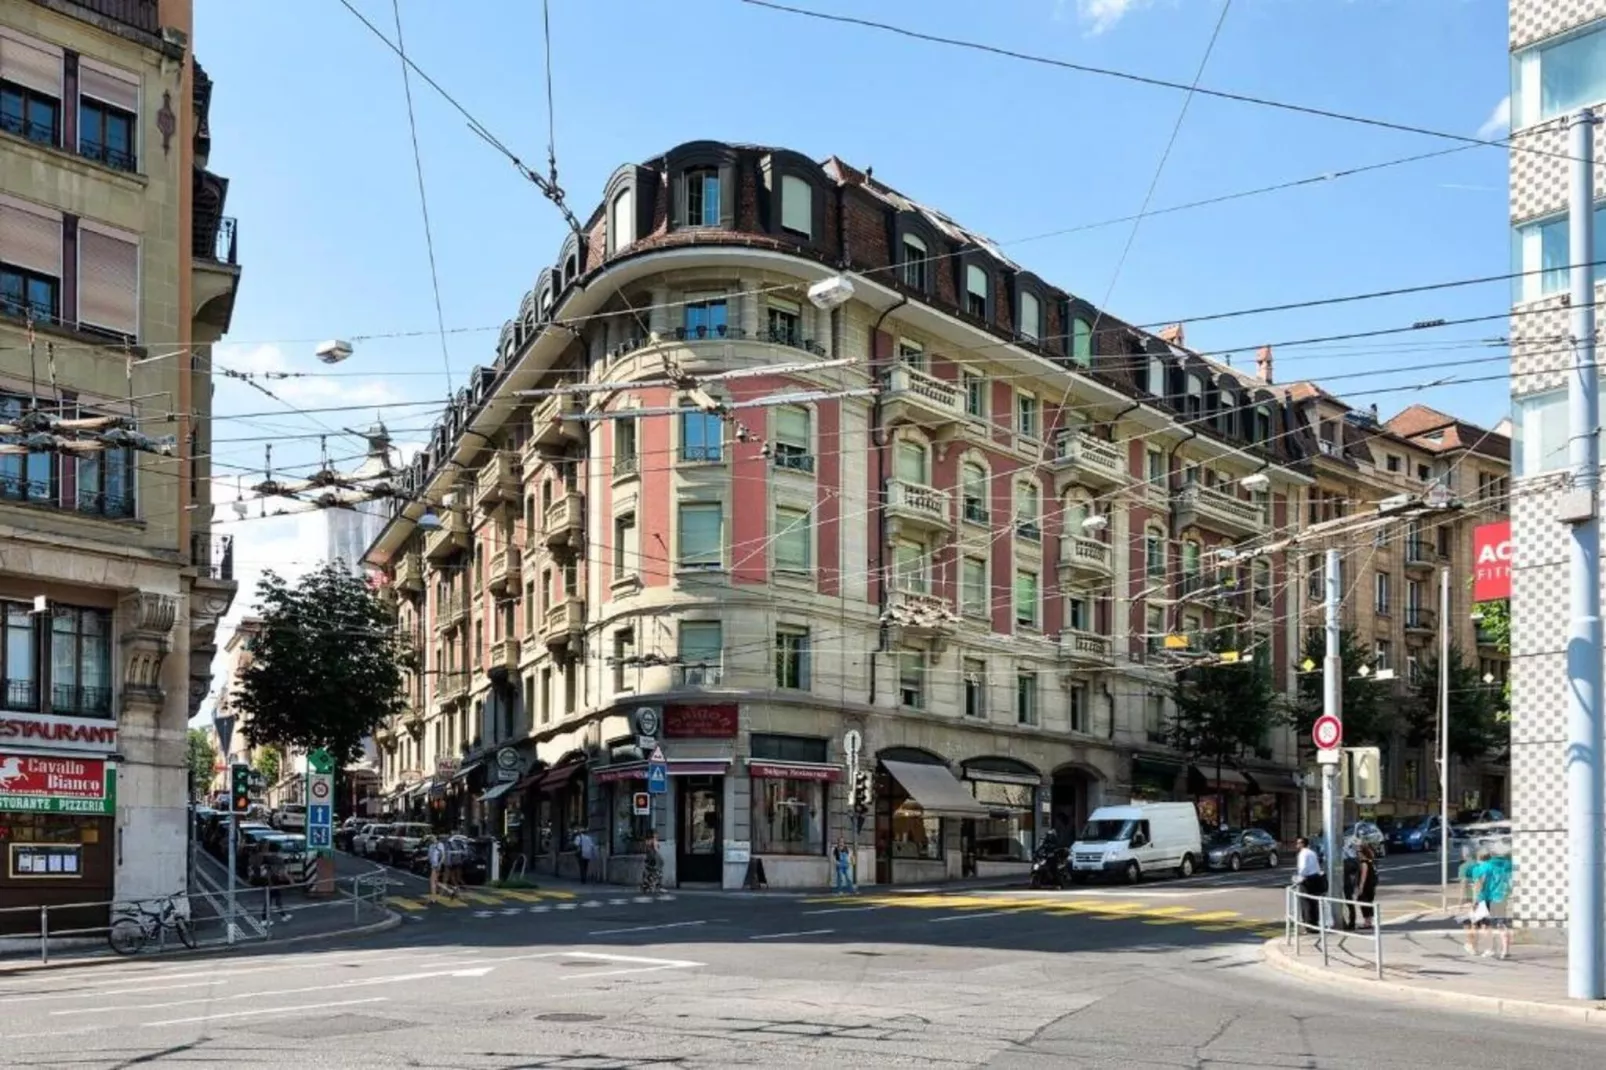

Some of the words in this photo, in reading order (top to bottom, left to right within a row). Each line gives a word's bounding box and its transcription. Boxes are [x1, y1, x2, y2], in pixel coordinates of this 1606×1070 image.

[28, 758, 85, 775] Cavallo
[47, 774, 100, 790] Bianco
[59, 798, 105, 812] PIZZERIA
